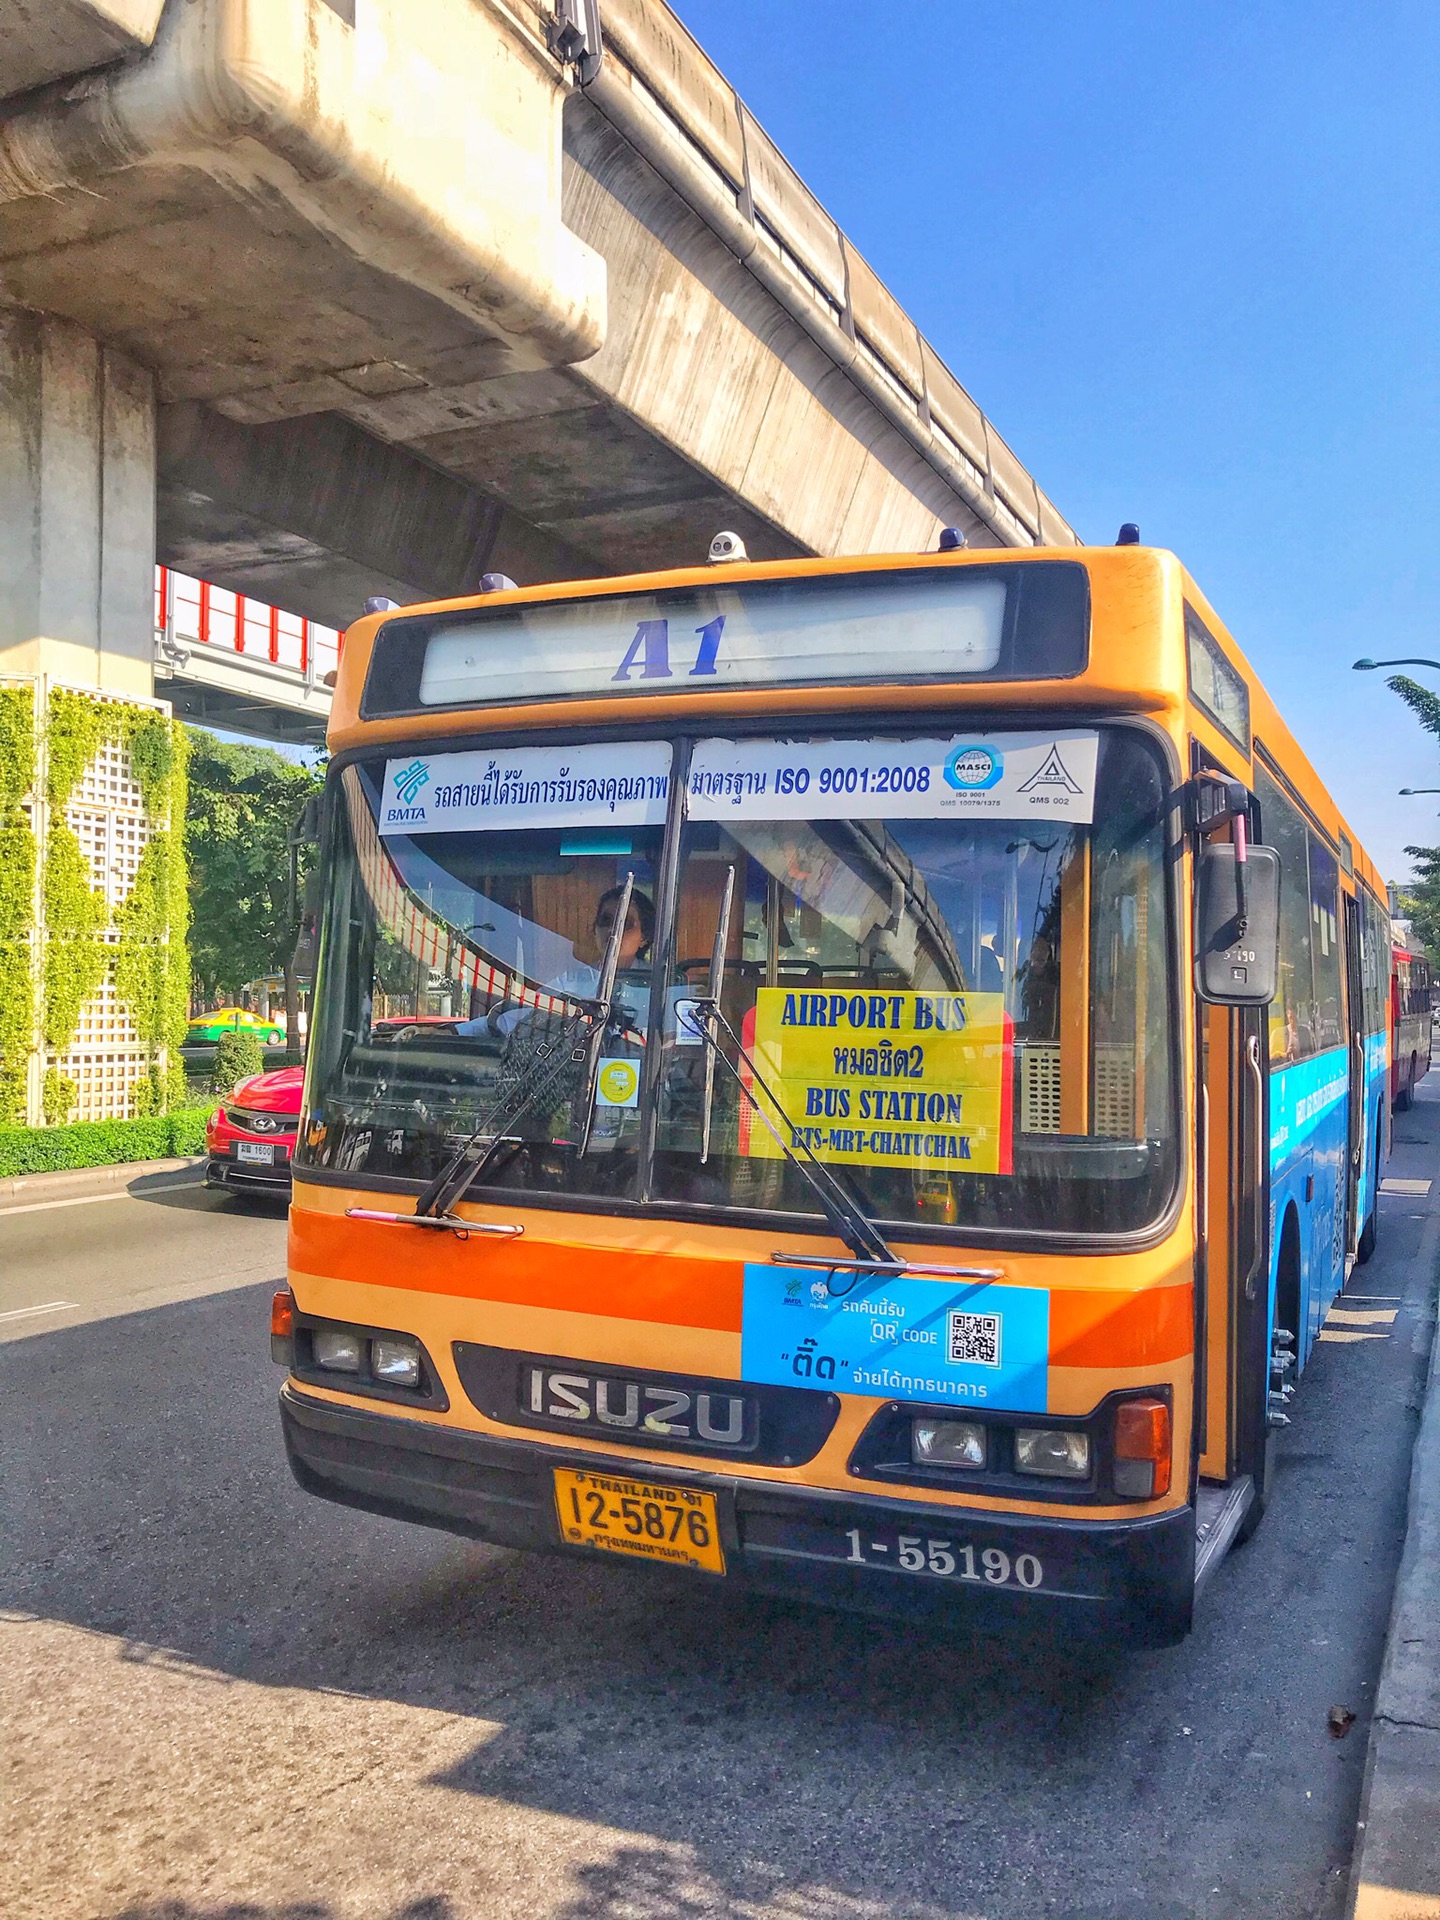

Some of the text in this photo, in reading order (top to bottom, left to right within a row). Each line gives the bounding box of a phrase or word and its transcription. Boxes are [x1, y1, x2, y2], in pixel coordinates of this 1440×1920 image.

[434, 761, 668, 812] รถสายนี้ได้รับการรับรองคุณภาพ
[691, 766, 930, 805] มาตรฐาน ISO 9001:2008
[1029, 796, 1070, 805] QMS 002
[388, 807, 425, 820] BMTA
[781, 994, 966, 1031] AIRPORT BUS
[833, 1039, 924, 1078] หมอชิต2
[805, 1087, 963, 1123] BUS STATION
[791, 1126, 971, 1160] BTS-MRT-CHATUCHAK
[842, 1297, 905, 1318] รถคันนี้รับ
[872, 1323, 938, 1345] QR CODE
[852, 1366, 988, 1398] จ่ายได้ทุกธนาคาร
[531, 1369, 744, 1443] ISUZU
[589, 1477, 676, 1502] THAILAND
[570, 1487, 710, 1548] 12-5876
